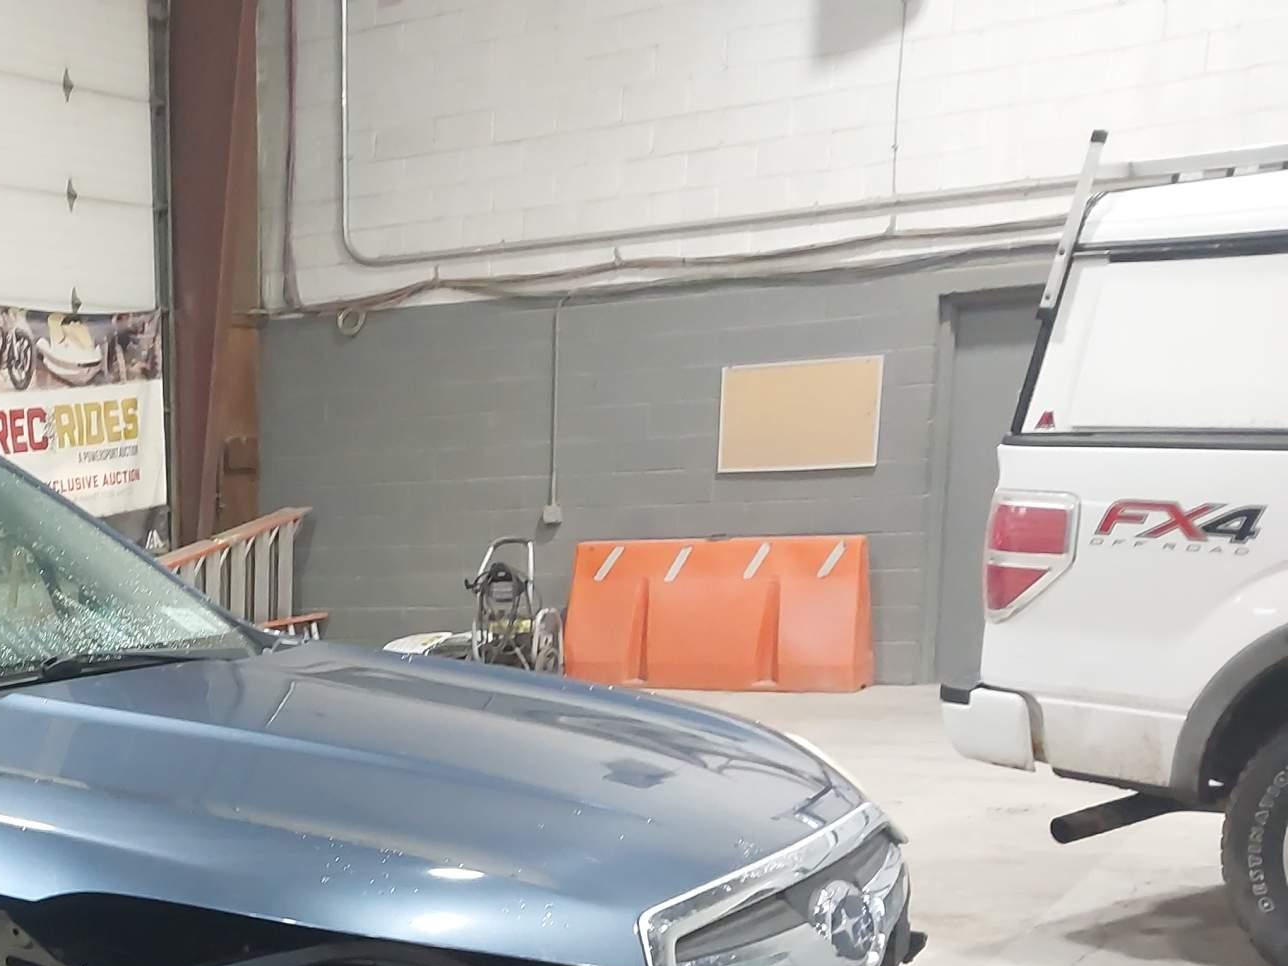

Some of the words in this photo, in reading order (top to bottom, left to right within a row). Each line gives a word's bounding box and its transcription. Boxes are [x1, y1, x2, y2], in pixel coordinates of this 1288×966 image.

[55, 397, 139, 449] RIDES
[102, 468, 142, 487] AUCTION
[1093, 499, 1268, 545] FX4
[1248, 767, 1288, 913] DESTINATIO
